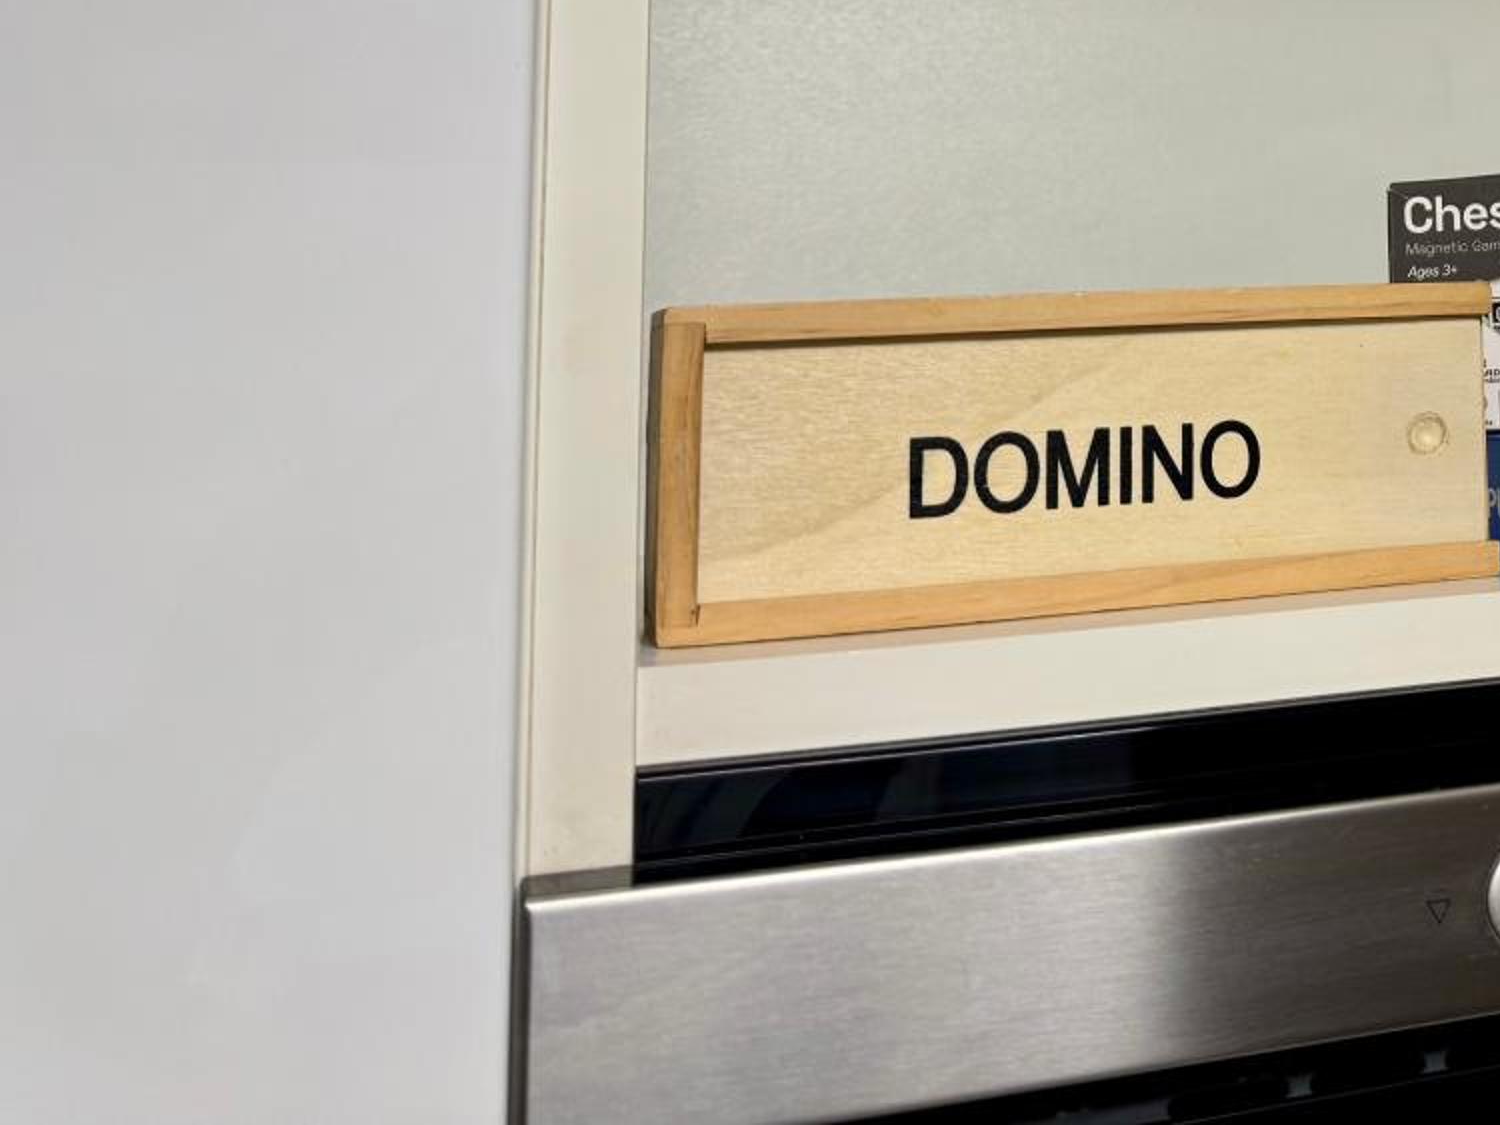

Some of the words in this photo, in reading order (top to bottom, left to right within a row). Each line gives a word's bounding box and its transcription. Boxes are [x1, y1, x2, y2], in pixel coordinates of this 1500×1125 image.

[1405, 240, 1468, 257] Magnetic
[1407, 265, 1440, 281] Ages
[1442, 263, 1457, 277] 3+
[909, 419, 1261, 519] DOMINO
